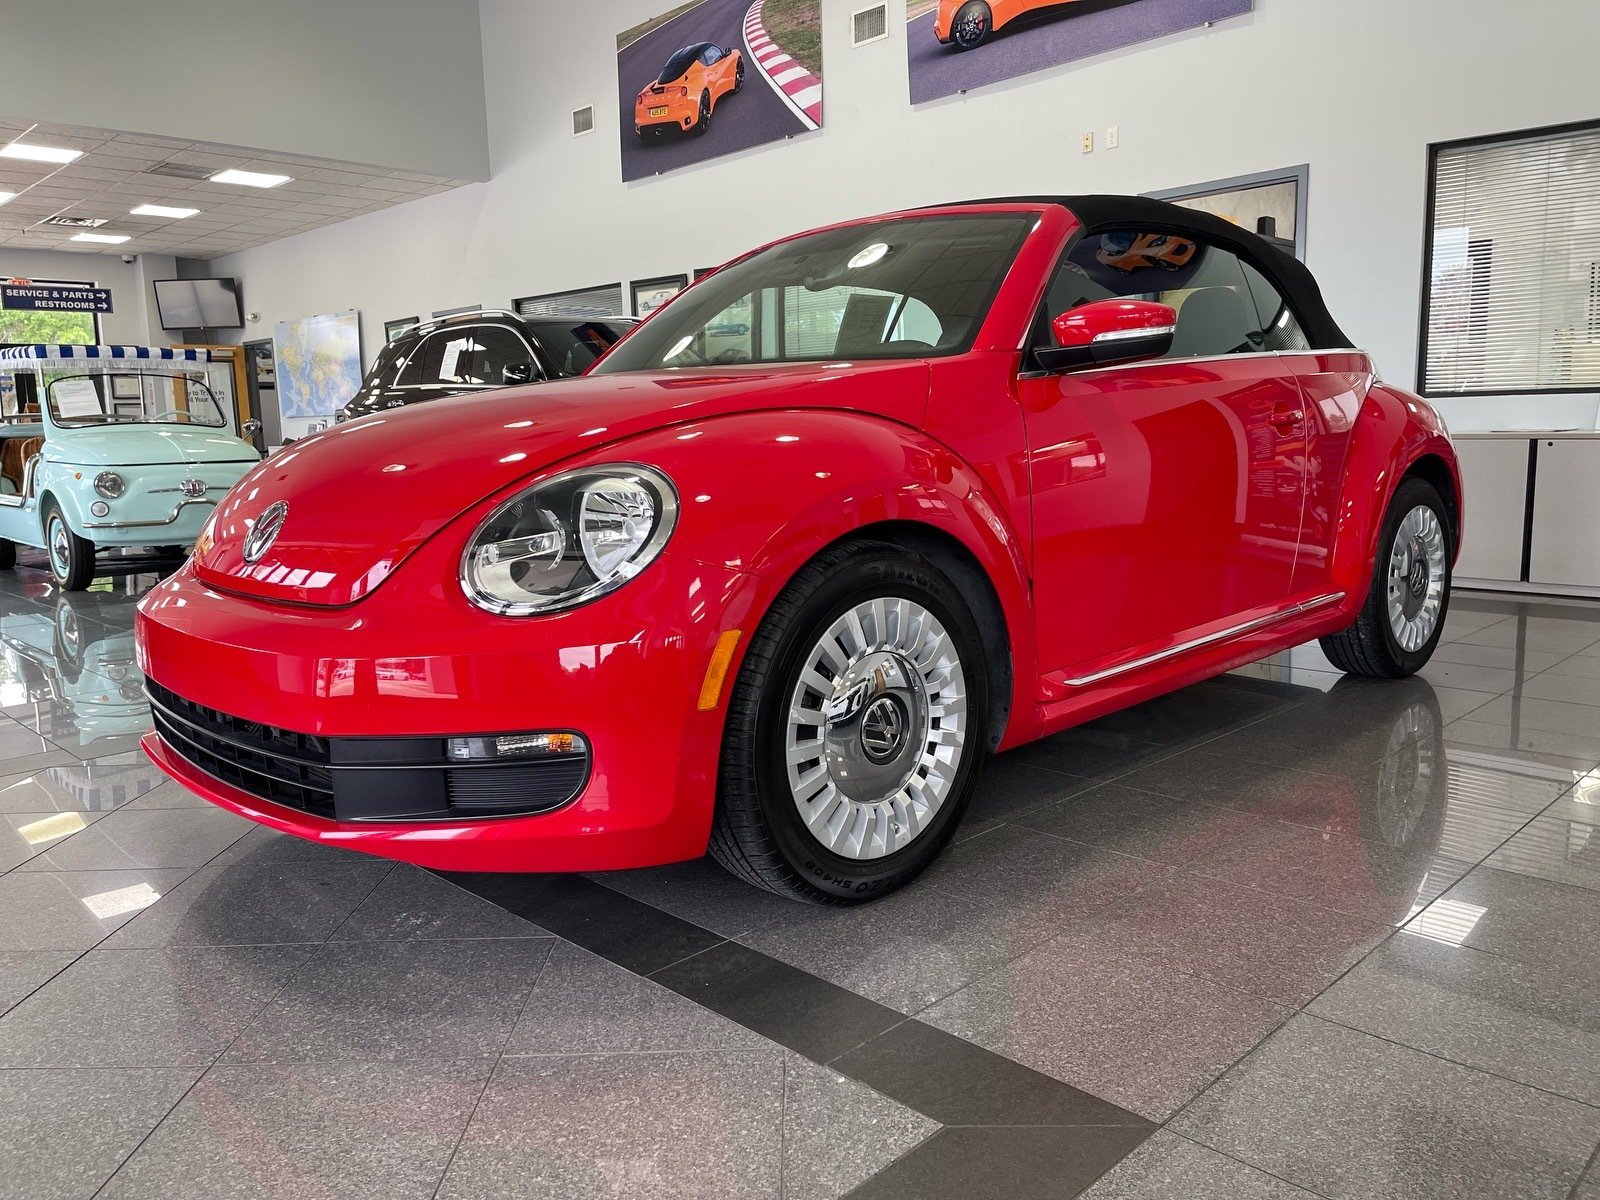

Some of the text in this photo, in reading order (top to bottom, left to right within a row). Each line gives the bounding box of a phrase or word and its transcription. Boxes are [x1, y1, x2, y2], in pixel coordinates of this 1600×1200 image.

[6, 289, 49, 298] SERVICE
[62, 291, 95, 299] PARTS
[35, 300, 95, 309] RESTROOMS
[805, 860, 853, 889] SH408
